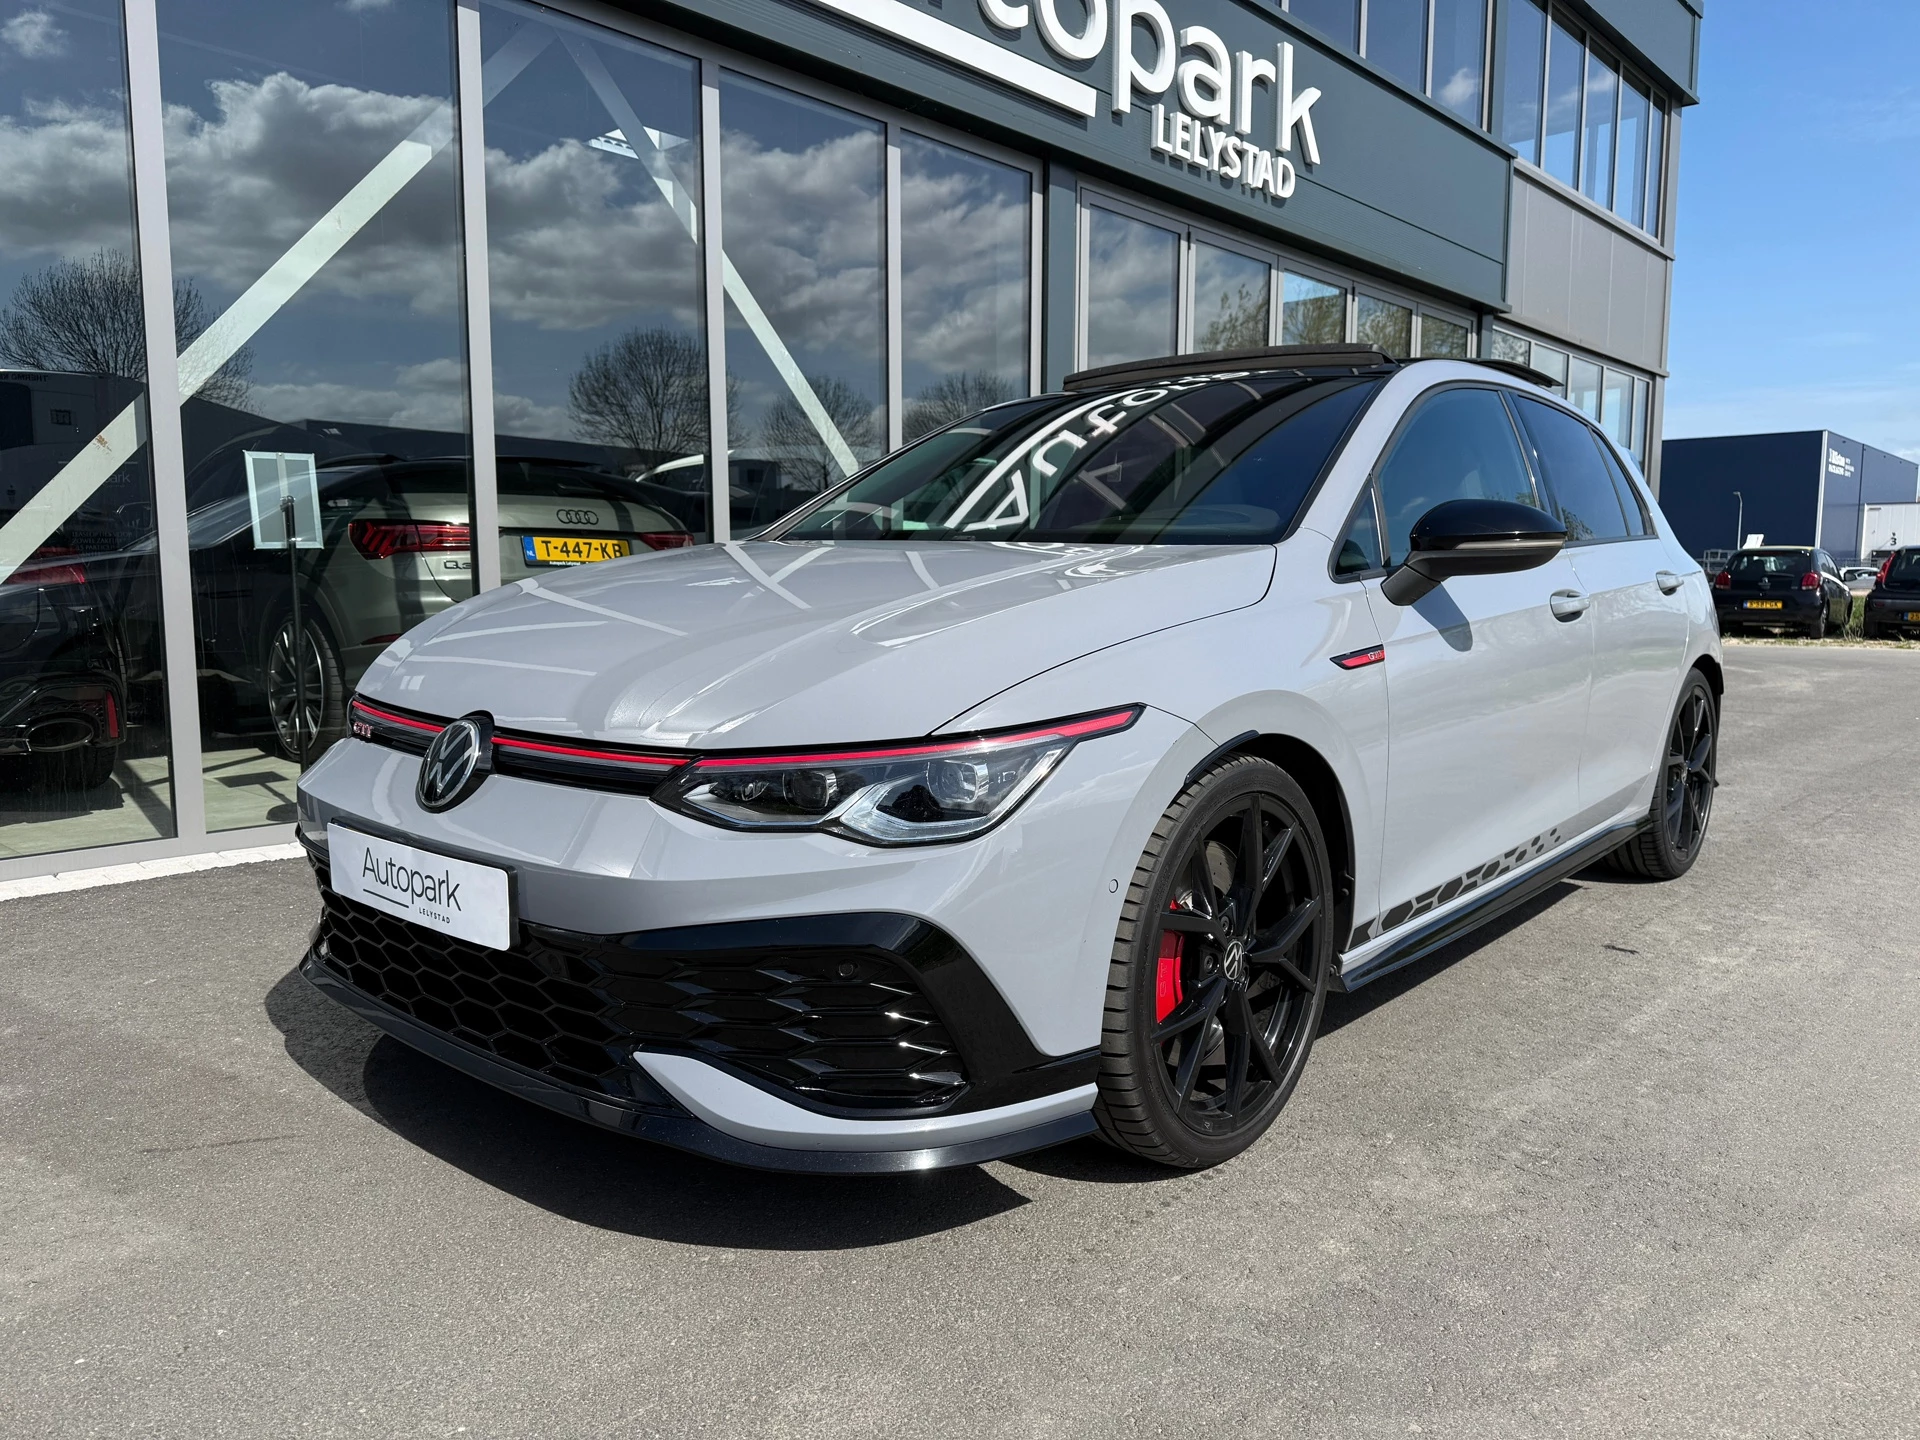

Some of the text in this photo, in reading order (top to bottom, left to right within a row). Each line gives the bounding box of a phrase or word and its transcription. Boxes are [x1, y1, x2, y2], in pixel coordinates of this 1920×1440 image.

[1151, 104, 1296, 199] LELYSTAD
[541, 540, 622, 559] T-447-KB
[353, 721, 373, 738] GTI
[362, 847, 462, 912] Autopark
[418, 906, 451, 924] LELYSTAD
